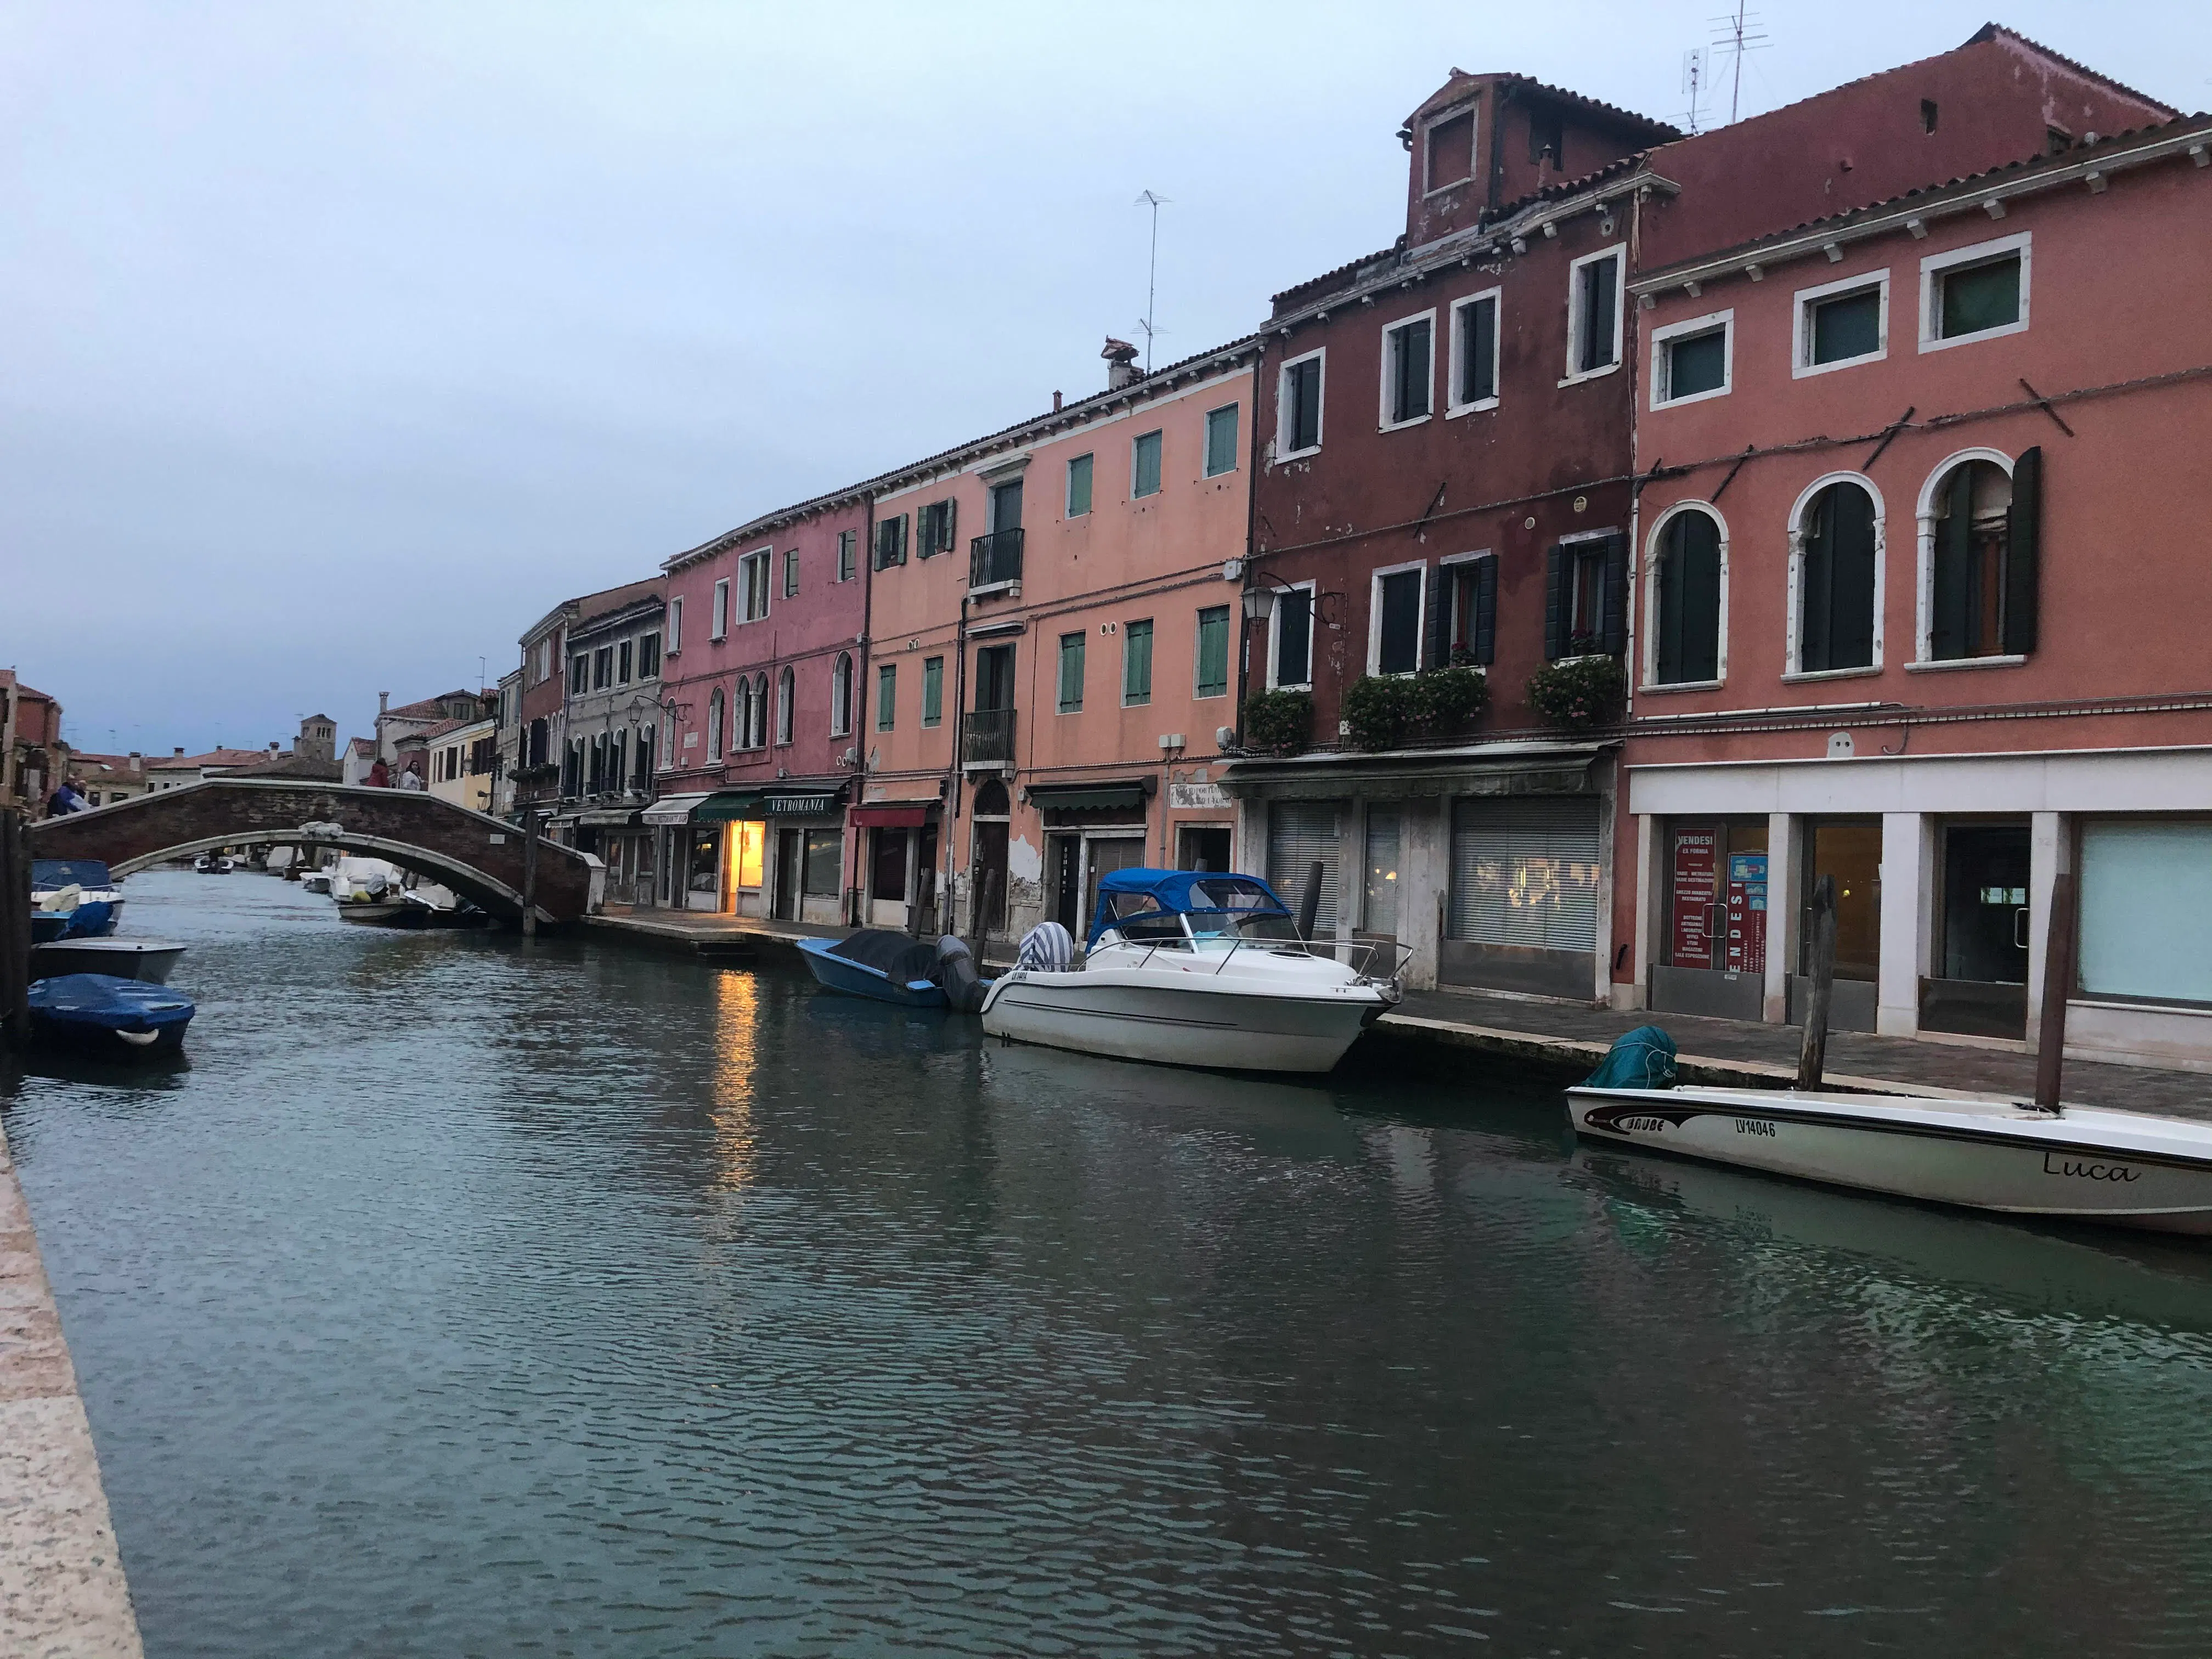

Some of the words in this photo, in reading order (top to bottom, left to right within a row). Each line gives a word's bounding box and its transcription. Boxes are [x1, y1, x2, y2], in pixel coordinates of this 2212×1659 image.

[772, 799, 824, 811] VETROMANIA
[1678, 836, 1713, 845] VENDESI
[1729, 883, 1742, 973] ENDESI
[2043, 1152, 2142, 1182] Luca
